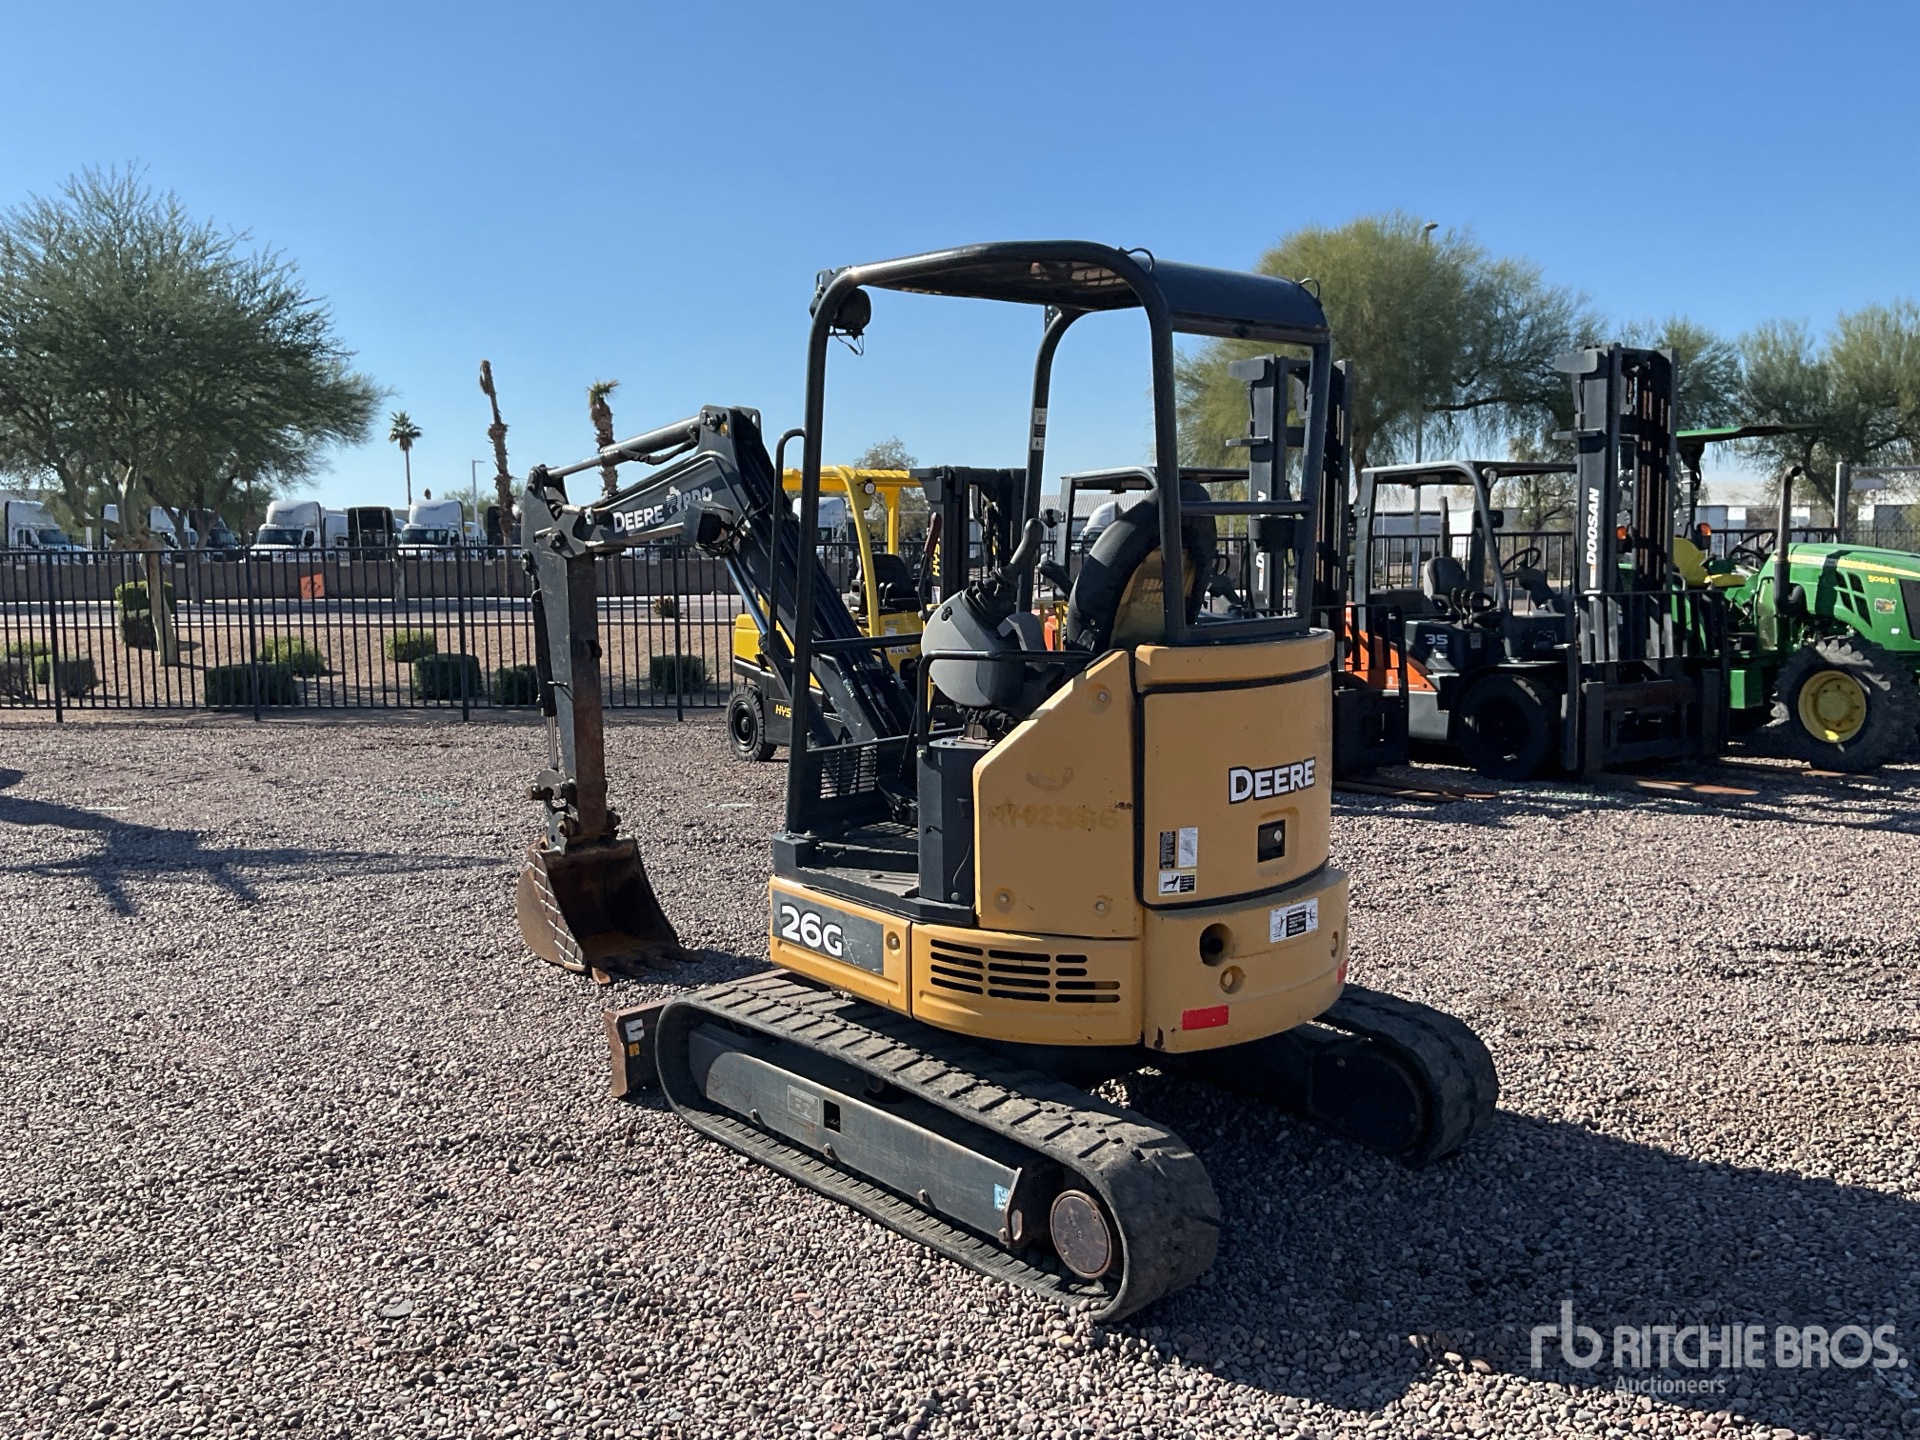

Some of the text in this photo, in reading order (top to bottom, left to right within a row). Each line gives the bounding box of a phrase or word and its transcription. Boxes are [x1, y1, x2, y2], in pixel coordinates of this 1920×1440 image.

[612, 504, 665, 533] DEERE
[1586, 487, 1600, 565] DOOSAN
[1424, 633, 1449, 645] 35
[775, 704, 792, 718] HYS
[1229, 758, 1315, 803] DEERE
[781, 904, 843, 957] 26G
